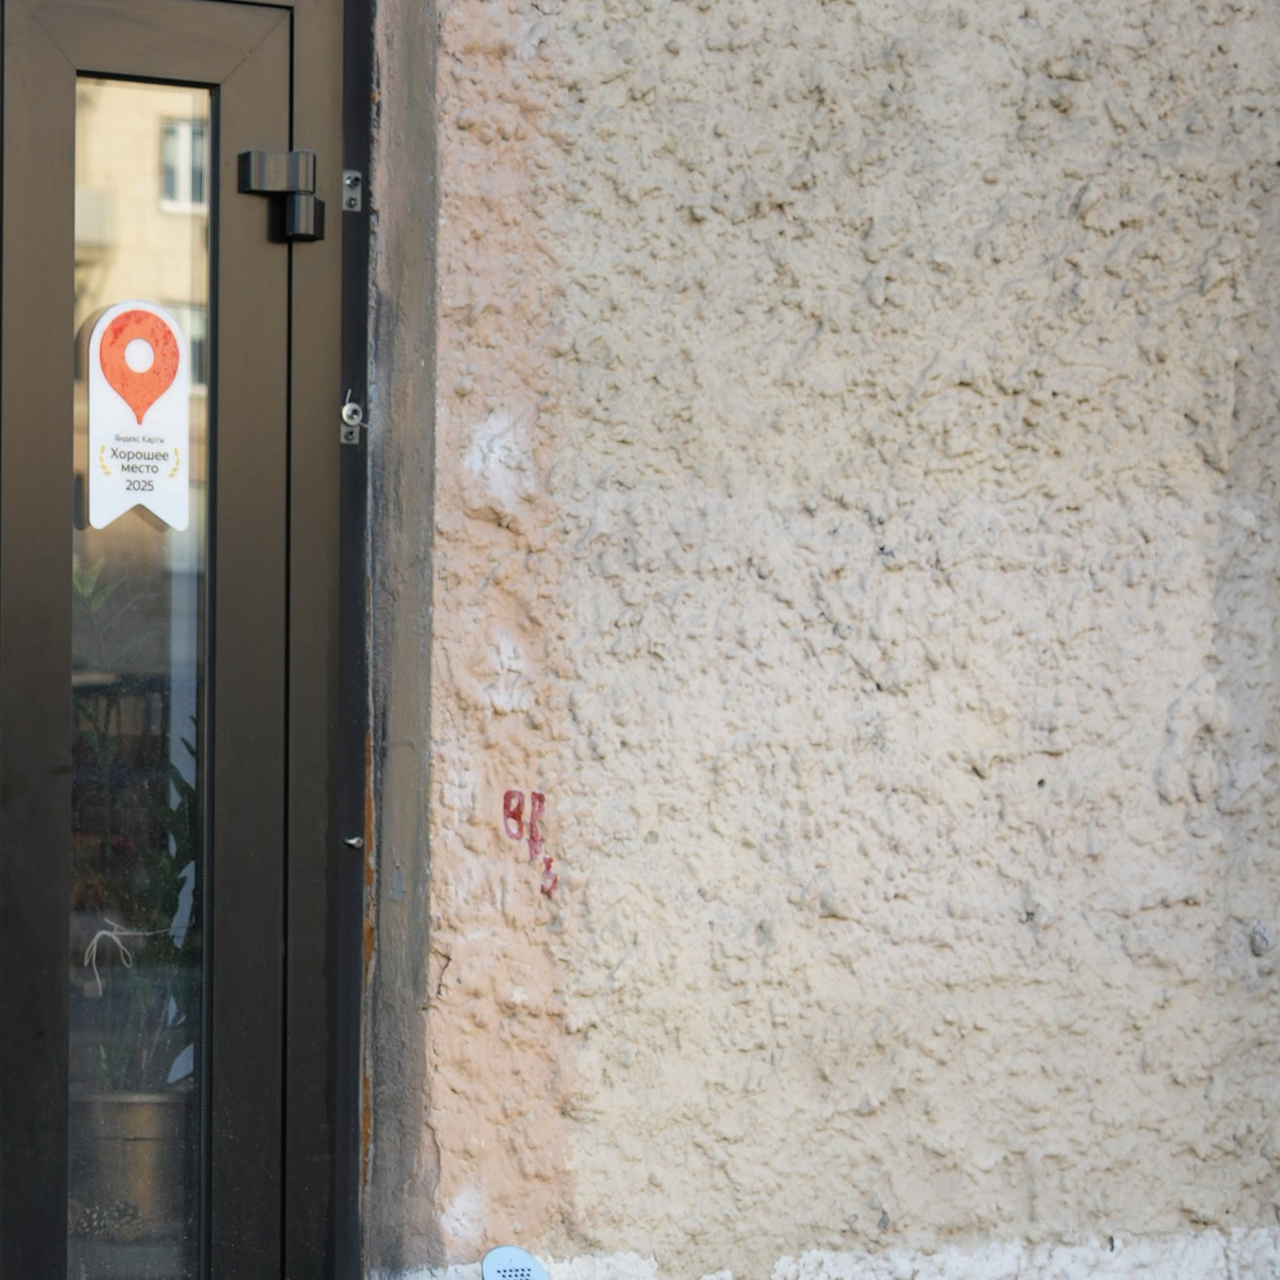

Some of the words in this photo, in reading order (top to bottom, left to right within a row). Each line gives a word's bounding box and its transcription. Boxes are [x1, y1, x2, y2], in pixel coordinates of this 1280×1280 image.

[115, 433, 140, 443] Яндекс
[142, 435, 166, 444] Карты
[110, 446, 170, 462] Хорошее
[121, 463, 159, 474] место
[125, 479, 155, 492] 2025
